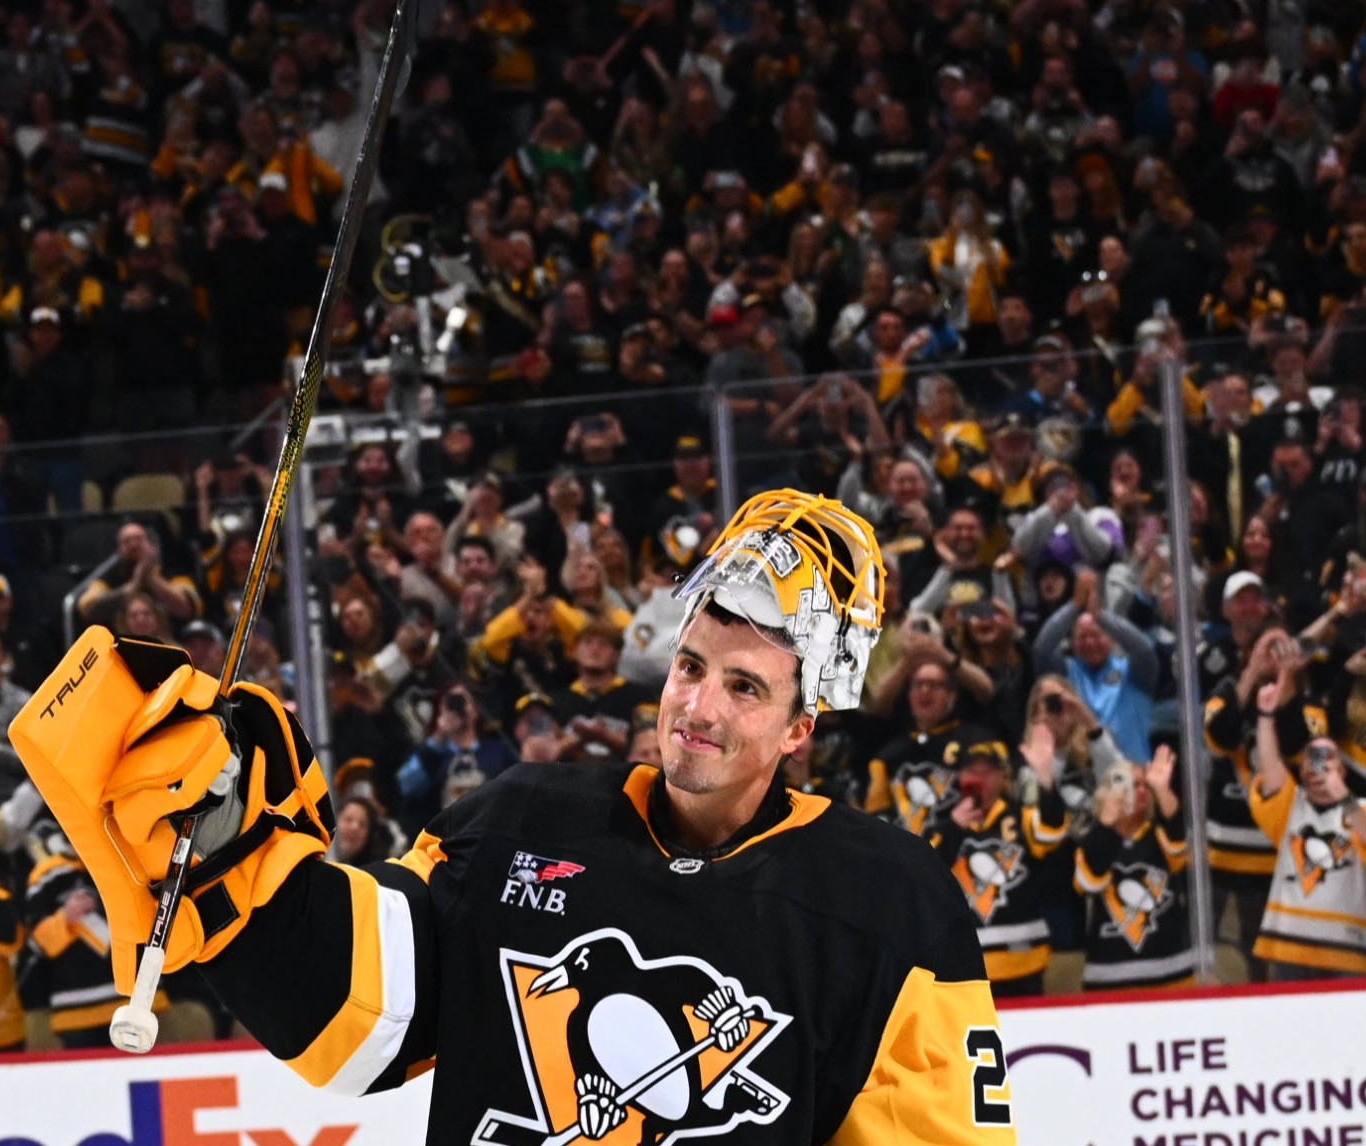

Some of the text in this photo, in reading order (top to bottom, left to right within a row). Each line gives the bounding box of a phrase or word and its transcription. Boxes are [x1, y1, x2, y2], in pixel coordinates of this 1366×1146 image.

[40, 647, 99, 719] TRUE
[150, 890, 171, 947] TRUE
[500, 878, 567, 916] F.N.B.
[1128, 1037, 1227, 1075] LIFE
